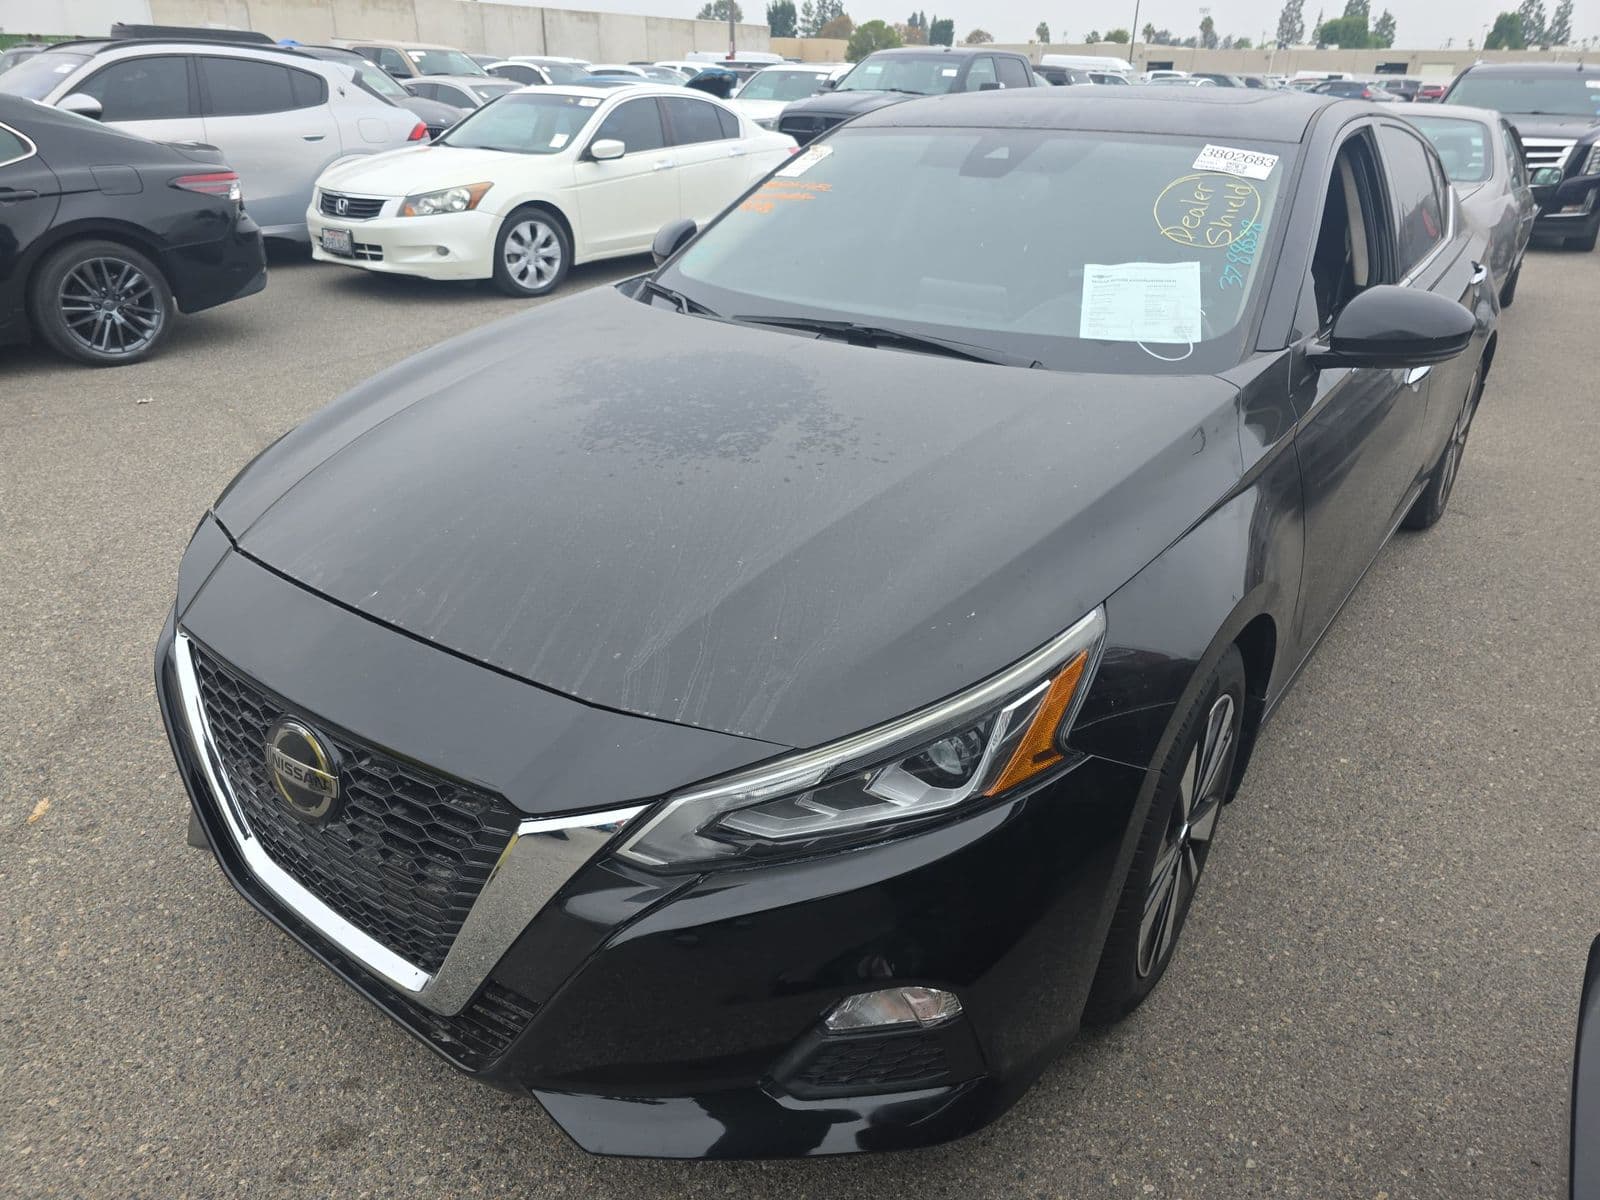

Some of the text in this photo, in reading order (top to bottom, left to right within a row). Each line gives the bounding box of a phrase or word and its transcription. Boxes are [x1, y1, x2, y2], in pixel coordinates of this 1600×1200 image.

[1162, 183, 1215, 242] Dealer
[1207, 184, 1252, 244] Shield
[272, 752, 331, 792] NISSAN
